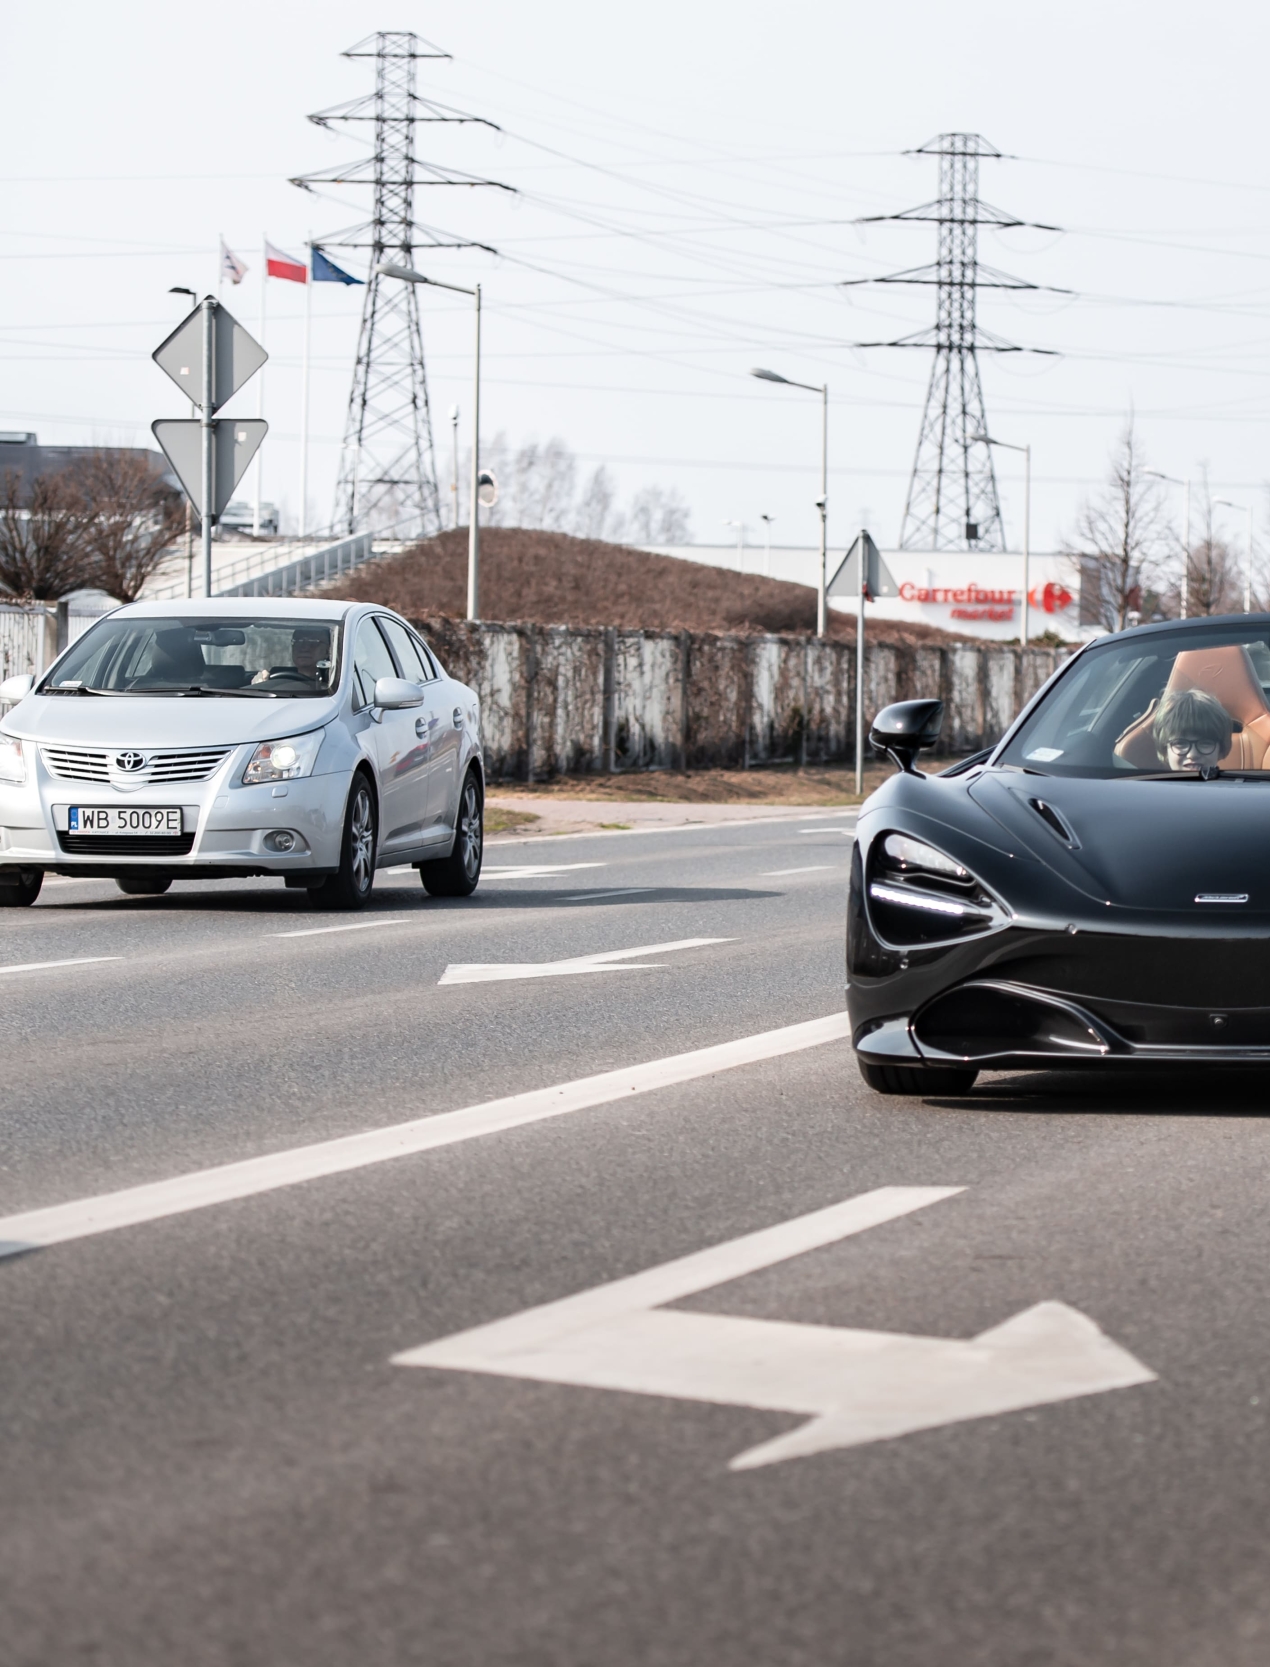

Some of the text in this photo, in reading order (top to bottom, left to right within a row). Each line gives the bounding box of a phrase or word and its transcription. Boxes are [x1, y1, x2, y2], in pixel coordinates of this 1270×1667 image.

[899, 581, 1016, 605] Carrefour
[950, 606, 1015, 621] market
[82, 810, 178, 830] WB 5009E
